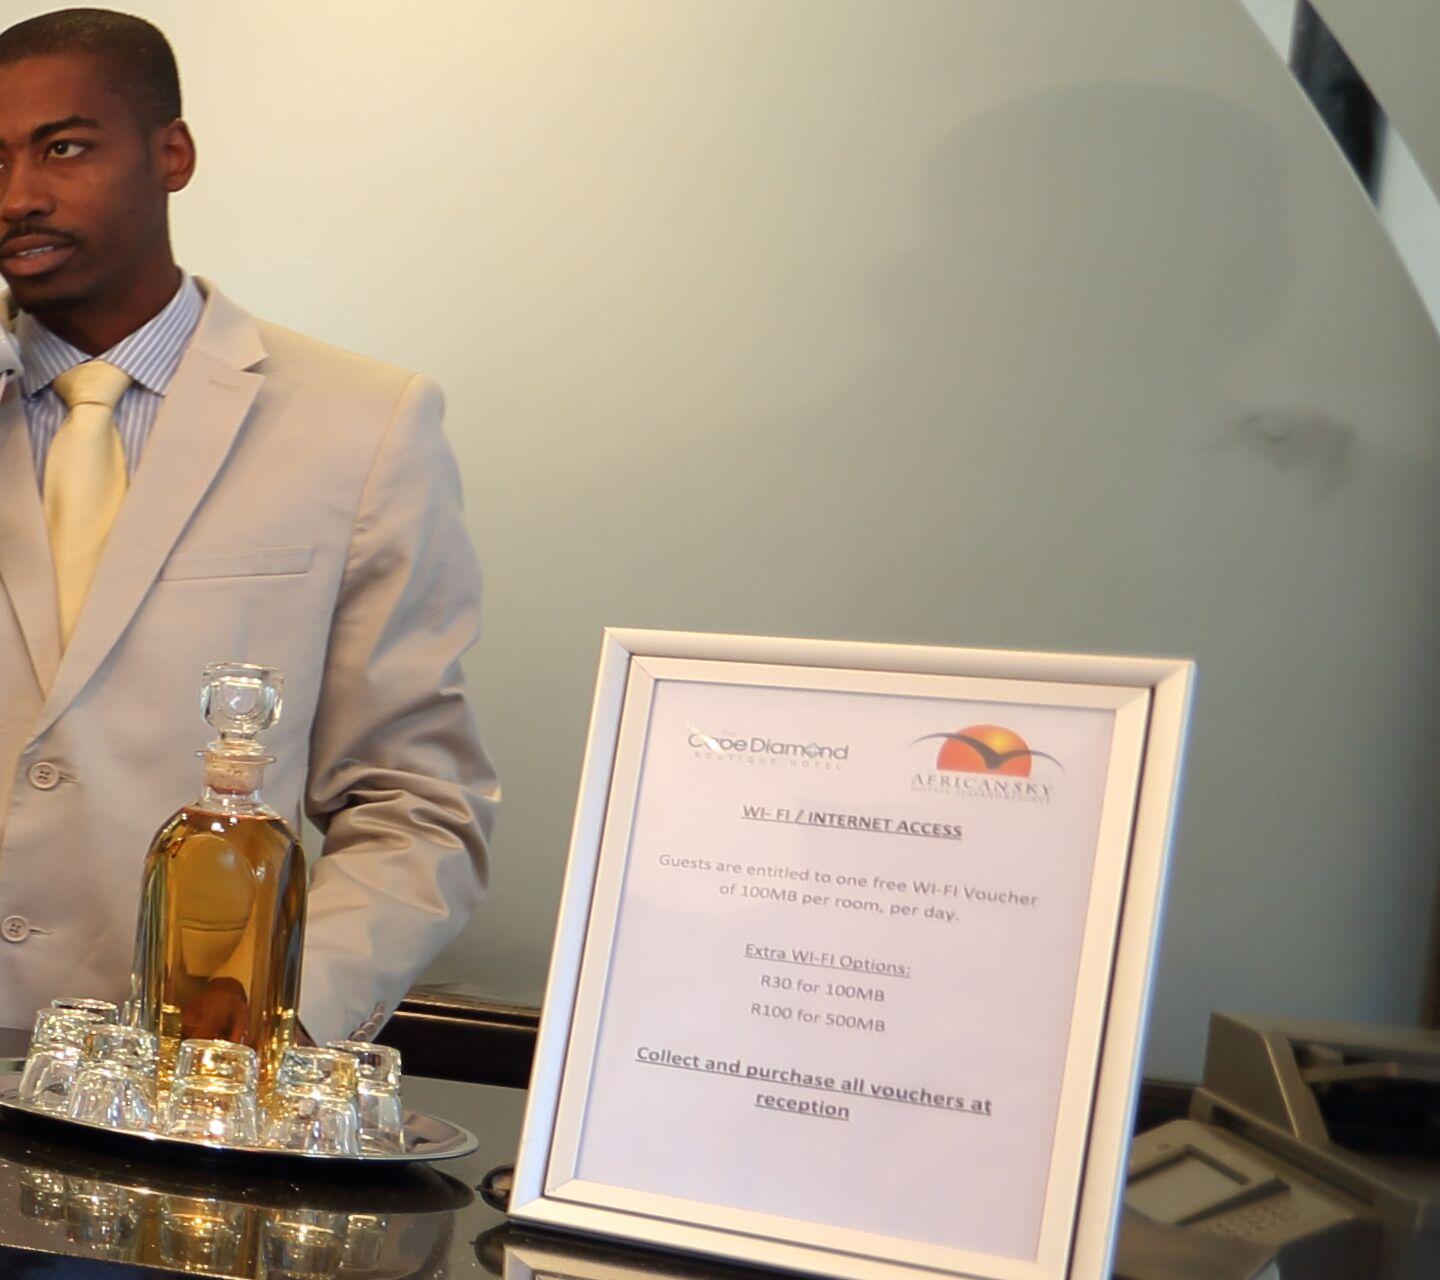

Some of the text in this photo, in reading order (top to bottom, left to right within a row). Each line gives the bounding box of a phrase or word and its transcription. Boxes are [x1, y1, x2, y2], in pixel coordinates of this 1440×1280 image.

[808, 811, 893, 831] INTERNET
[896, 820, 963, 838] ACCESS
[658, 853, 1039, 907] Guests are entitled to one free WI-FI Voucher
[719, 882, 736, 896] of
[741, 884, 798, 903] 100MB
[801, 893, 830, 909] per
[889, 902, 918, 919] per
[744, 943, 912, 979] Extra WI-FI Options:
[760, 974, 885, 1002] R30 for 100MB
[750, 1003, 886, 1032] R100 for 500MB
[636, 1046, 993, 1114] Collect and purchase all vouchers at
[755, 1092, 850, 1120] reception
